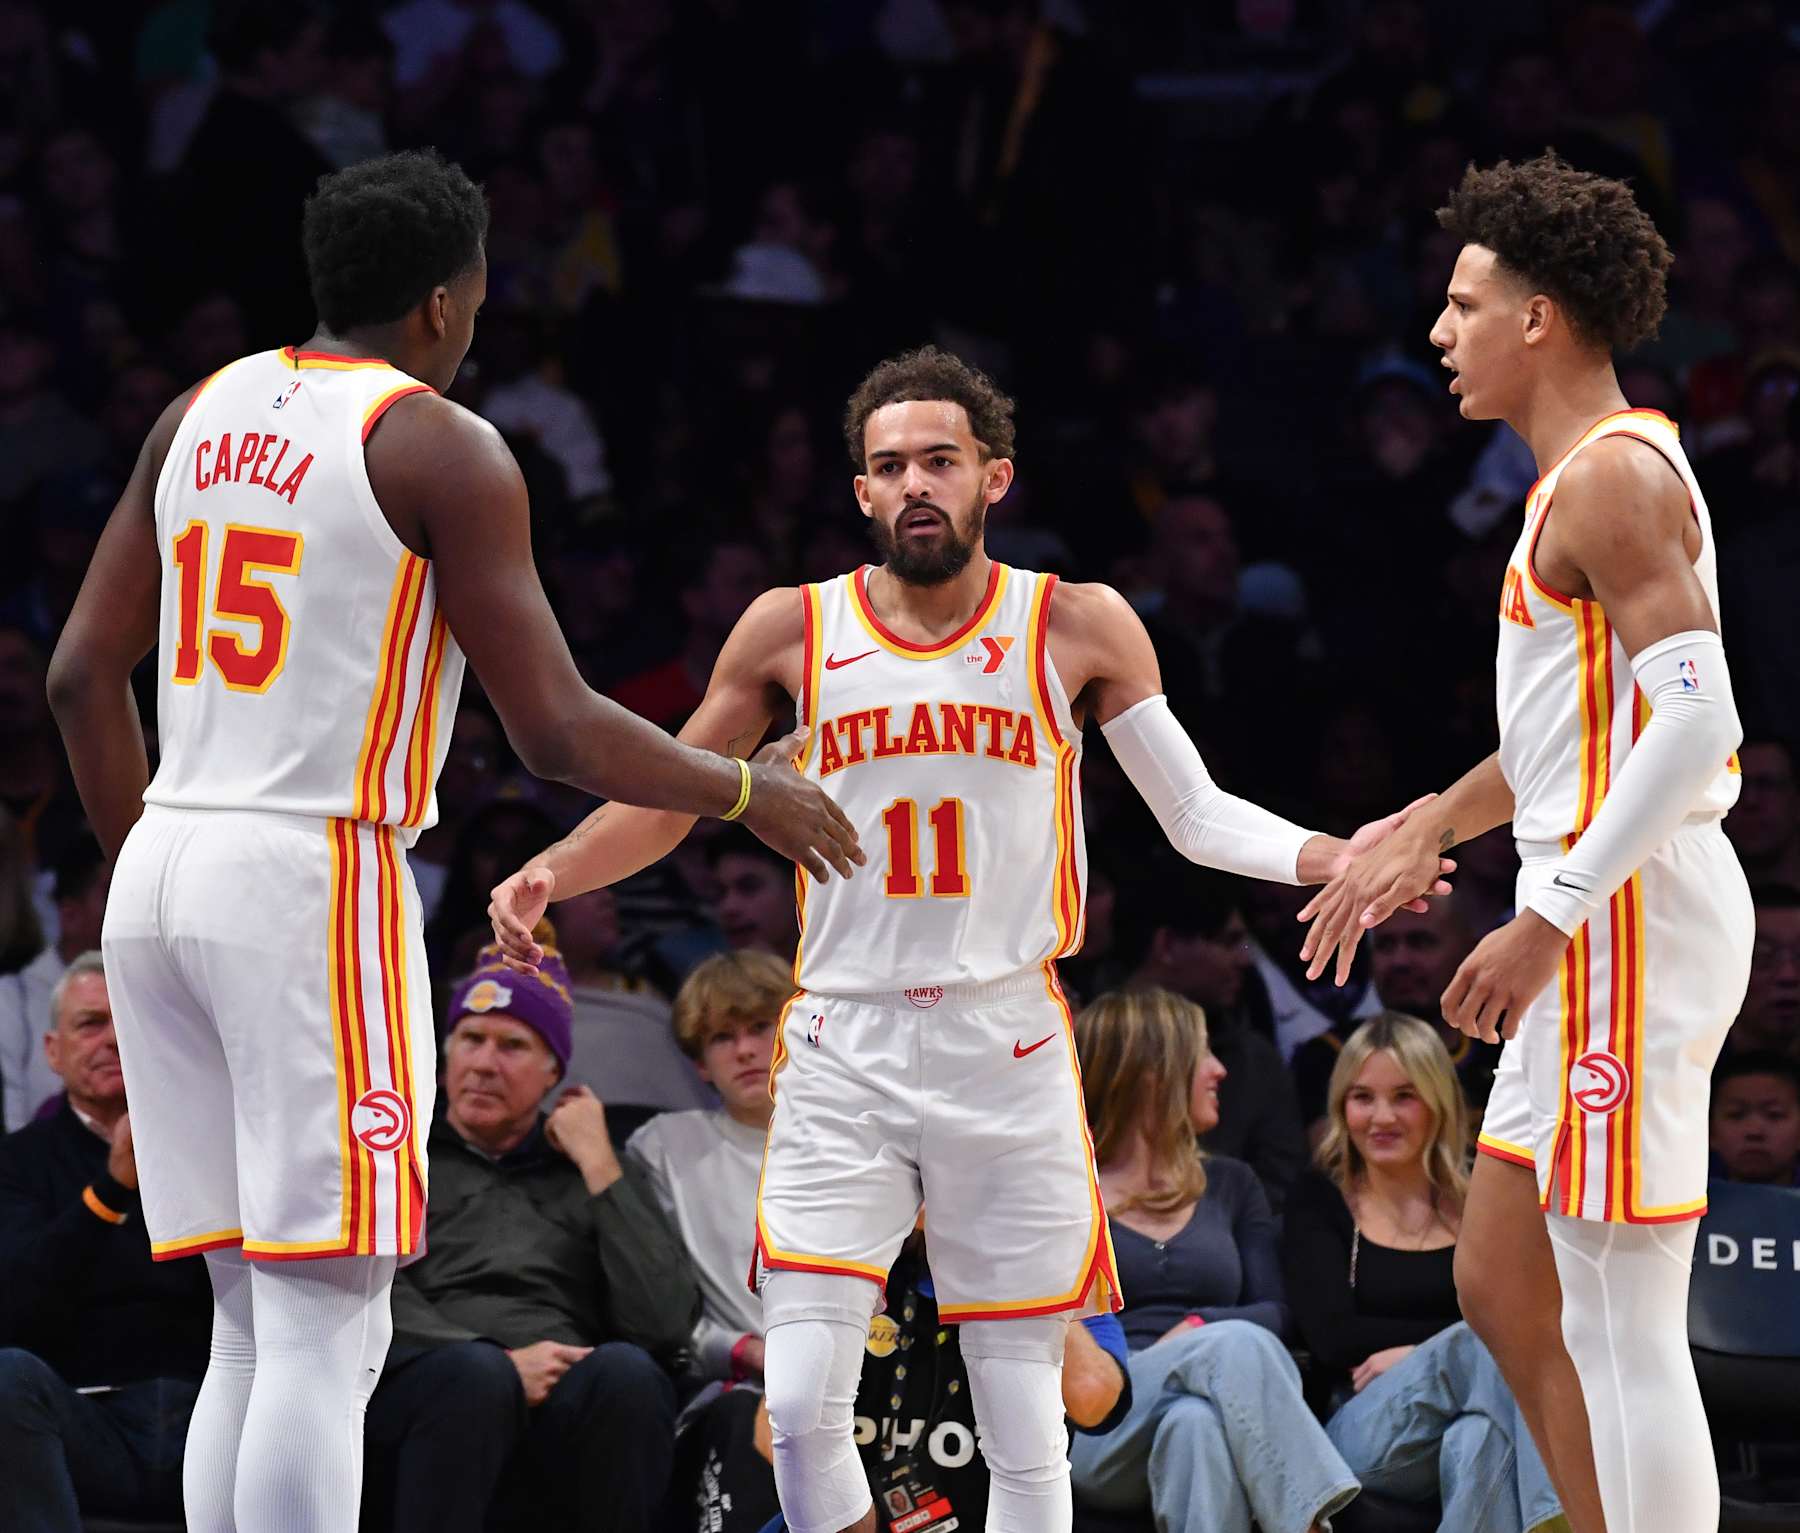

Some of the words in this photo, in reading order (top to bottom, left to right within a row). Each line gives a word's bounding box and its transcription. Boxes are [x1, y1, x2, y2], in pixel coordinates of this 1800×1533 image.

[195, 432, 315, 505] CAPELA
[171, 519, 304, 695] 15
[966, 654, 984, 664] the
[819, 700, 1038, 780] ATLANTA
[881, 796, 972, 898] 11
[904, 985, 944, 999] HAWKS
[853, 1415, 980, 1469] PHO
